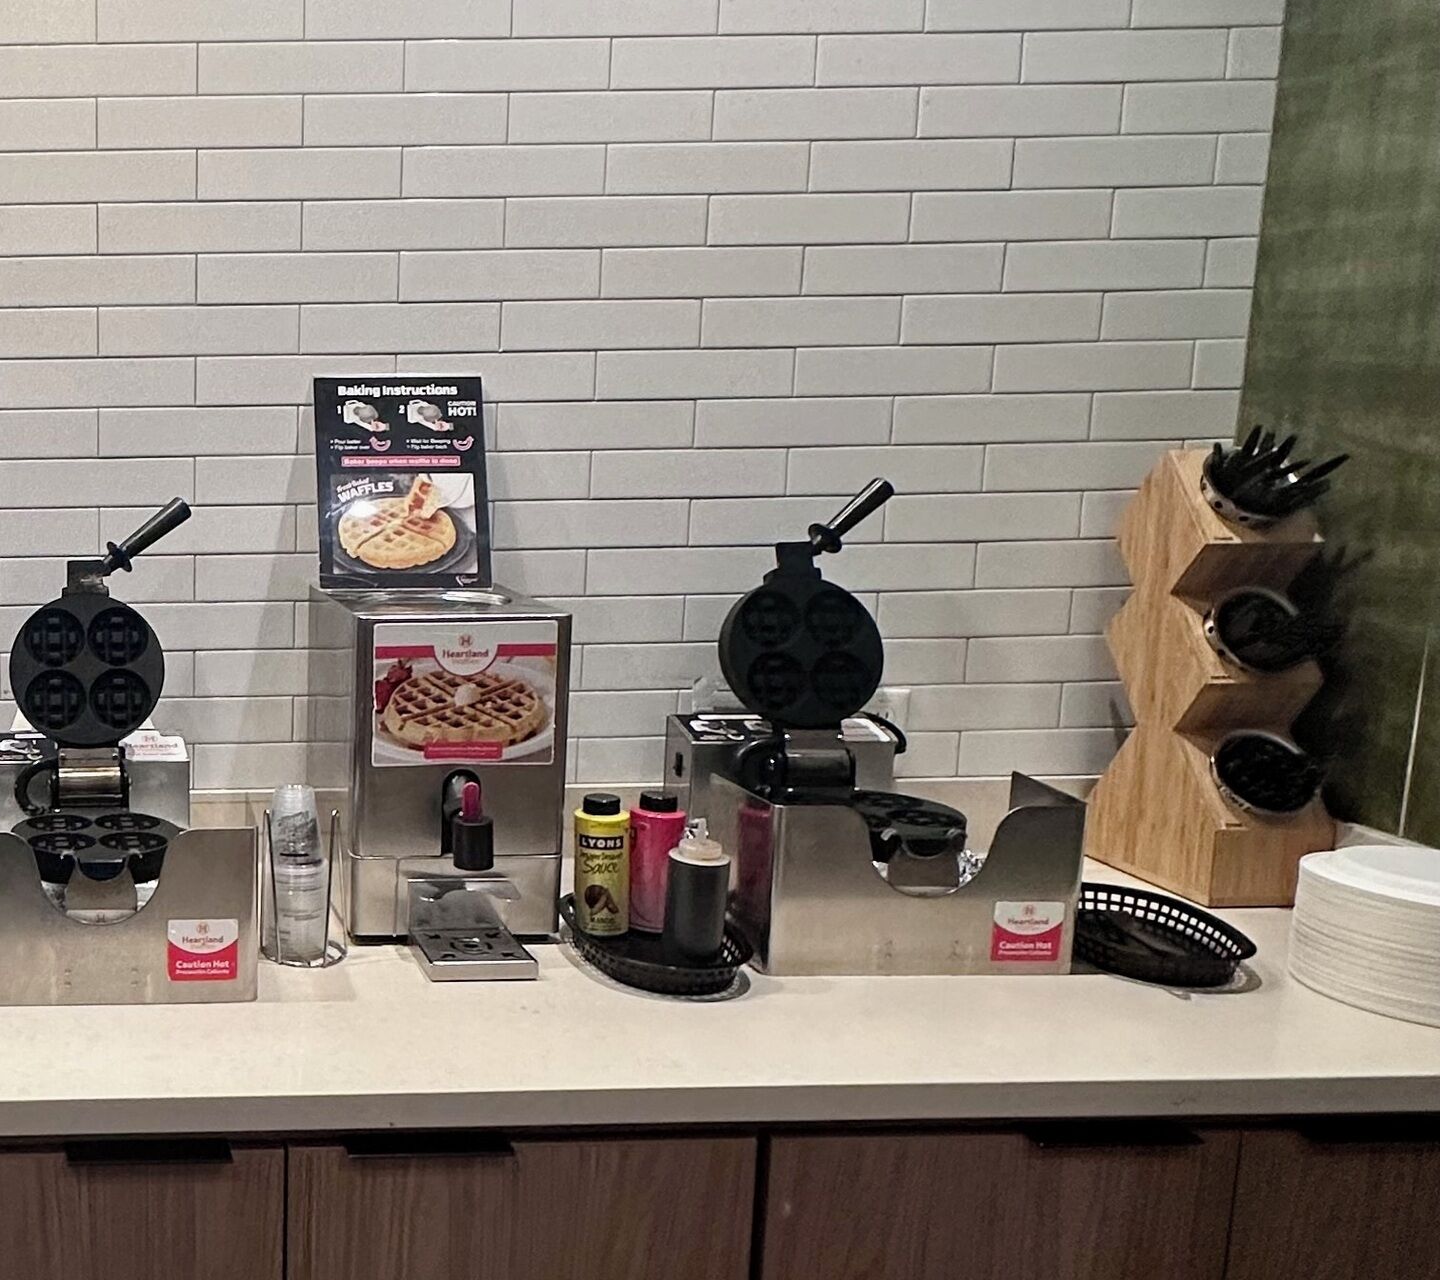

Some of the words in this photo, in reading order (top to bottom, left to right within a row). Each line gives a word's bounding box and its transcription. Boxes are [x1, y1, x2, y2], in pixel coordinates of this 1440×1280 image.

[337, 384, 381, 398] Baking
[382, 384, 458, 396] Instructions
[336, 405, 342, 415] 1
[398, 405, 406, 415] 2
[447, 407, 478, 417] HOT!
[337, 481, 394, 503] WAFFLES
[442, 648, 489, 659] Heartland
[581, 837, 622, 848] LYONS
[582, 860, 620, 875] Sauce
[182, 935, 225, 944] Heartland
[999, 940, 1035, 950] Caution
[1035, 941, 1053, 950] Hot
[175, 960, 212, 969] Caution
[212, 960, 230, 968] Hot
